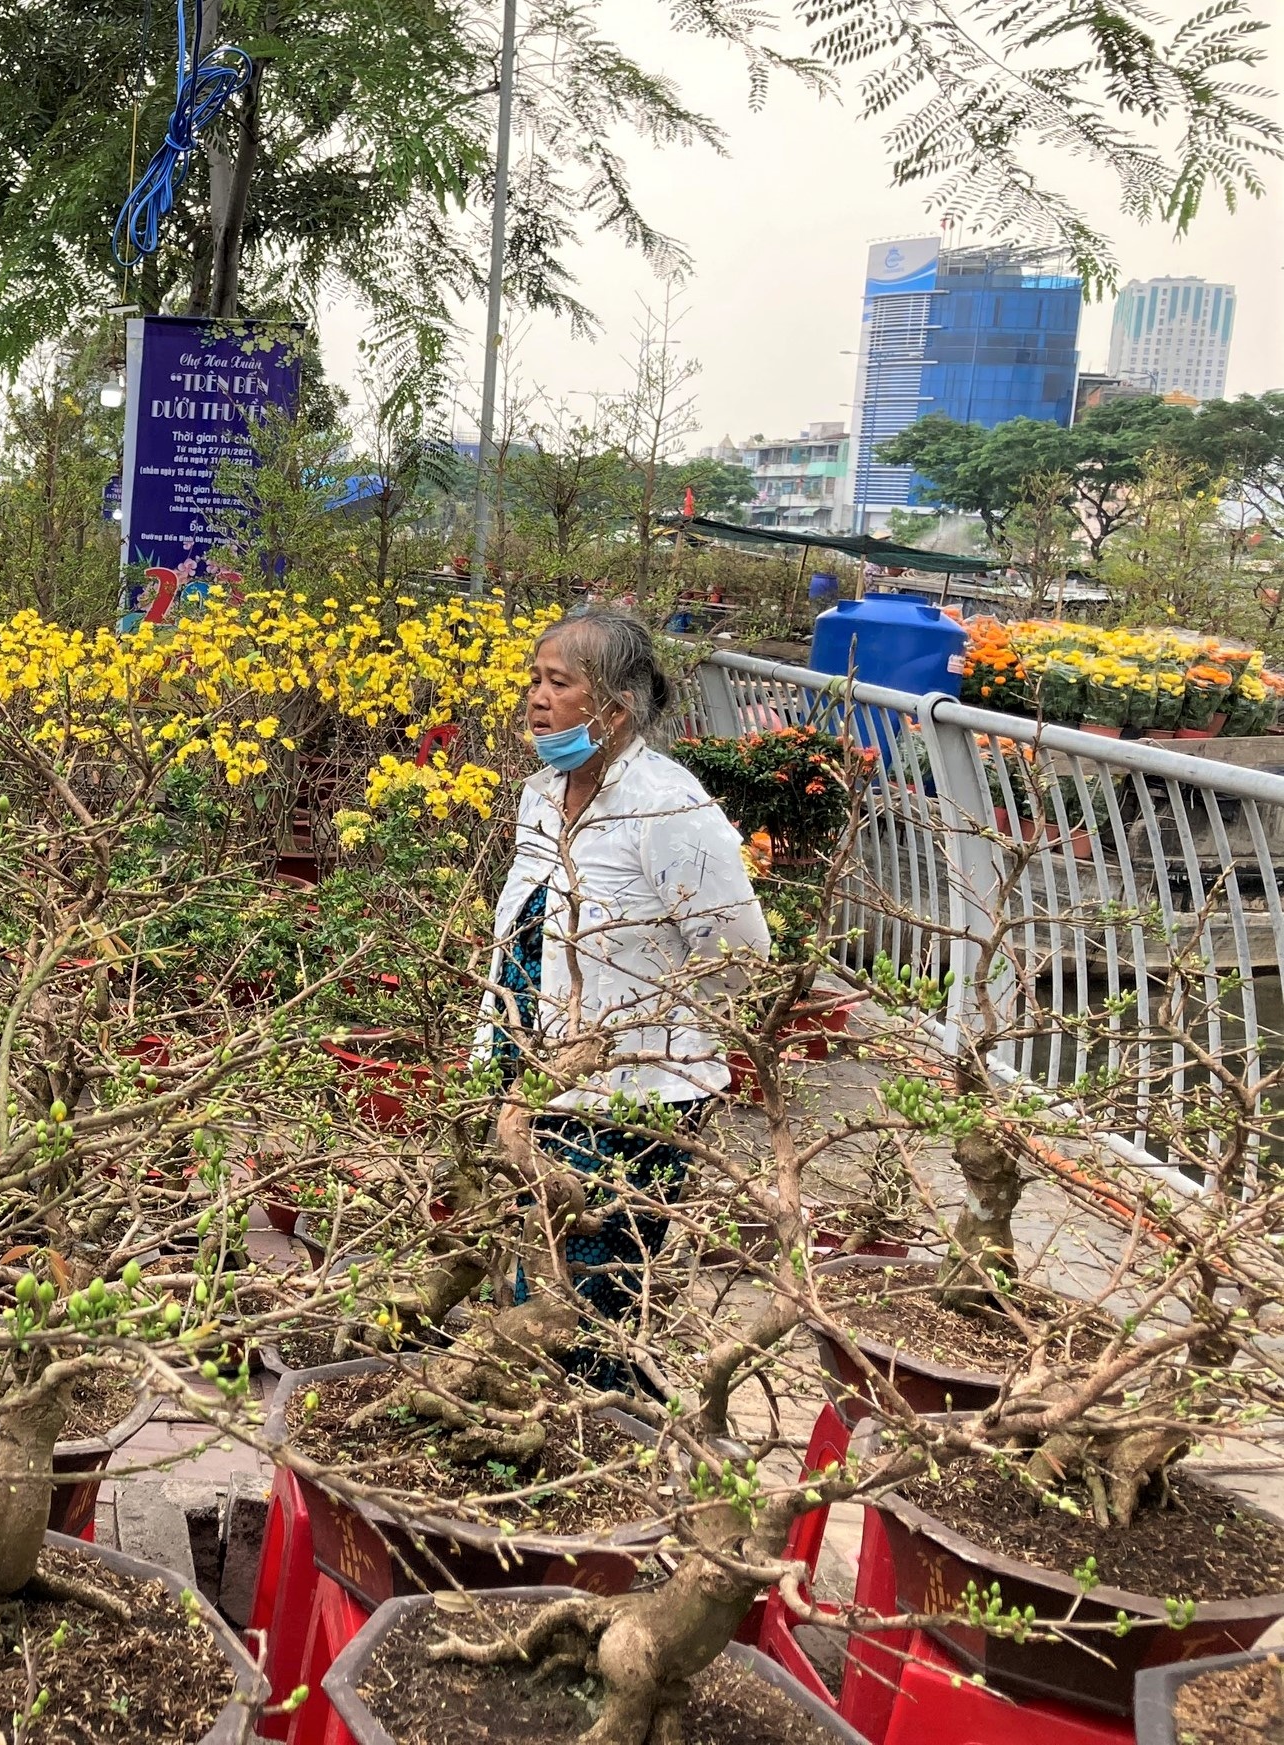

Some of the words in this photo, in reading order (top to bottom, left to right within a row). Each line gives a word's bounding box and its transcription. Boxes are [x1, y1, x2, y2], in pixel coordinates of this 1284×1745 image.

[180, 353, 201, 369] Chợ
[204, 354, 227, 368] Hoa
[233, 371, 269, 395] BẾN
[151, 397, 196, 420] DƯỚI
[172, 431, 194, 442] Thời
[196, 434, 217, 445] gian
[176, 445, 186, 453] Từ
[188, 446, 206, 455] ngày
[208, 446, 252, 456] 27/01/2021
[174, 455, 189, 463] đến
[190, 456, 208, 465] ngày
[160, 466, 176, 477] ngày
[185, 467, 197, 477] đến
[198, 468, 213, 478] ngày
[174, 483, 191, 493] Thời
[193, 485, 210, 495] gian
[190, 520, 204, 533] Địa
